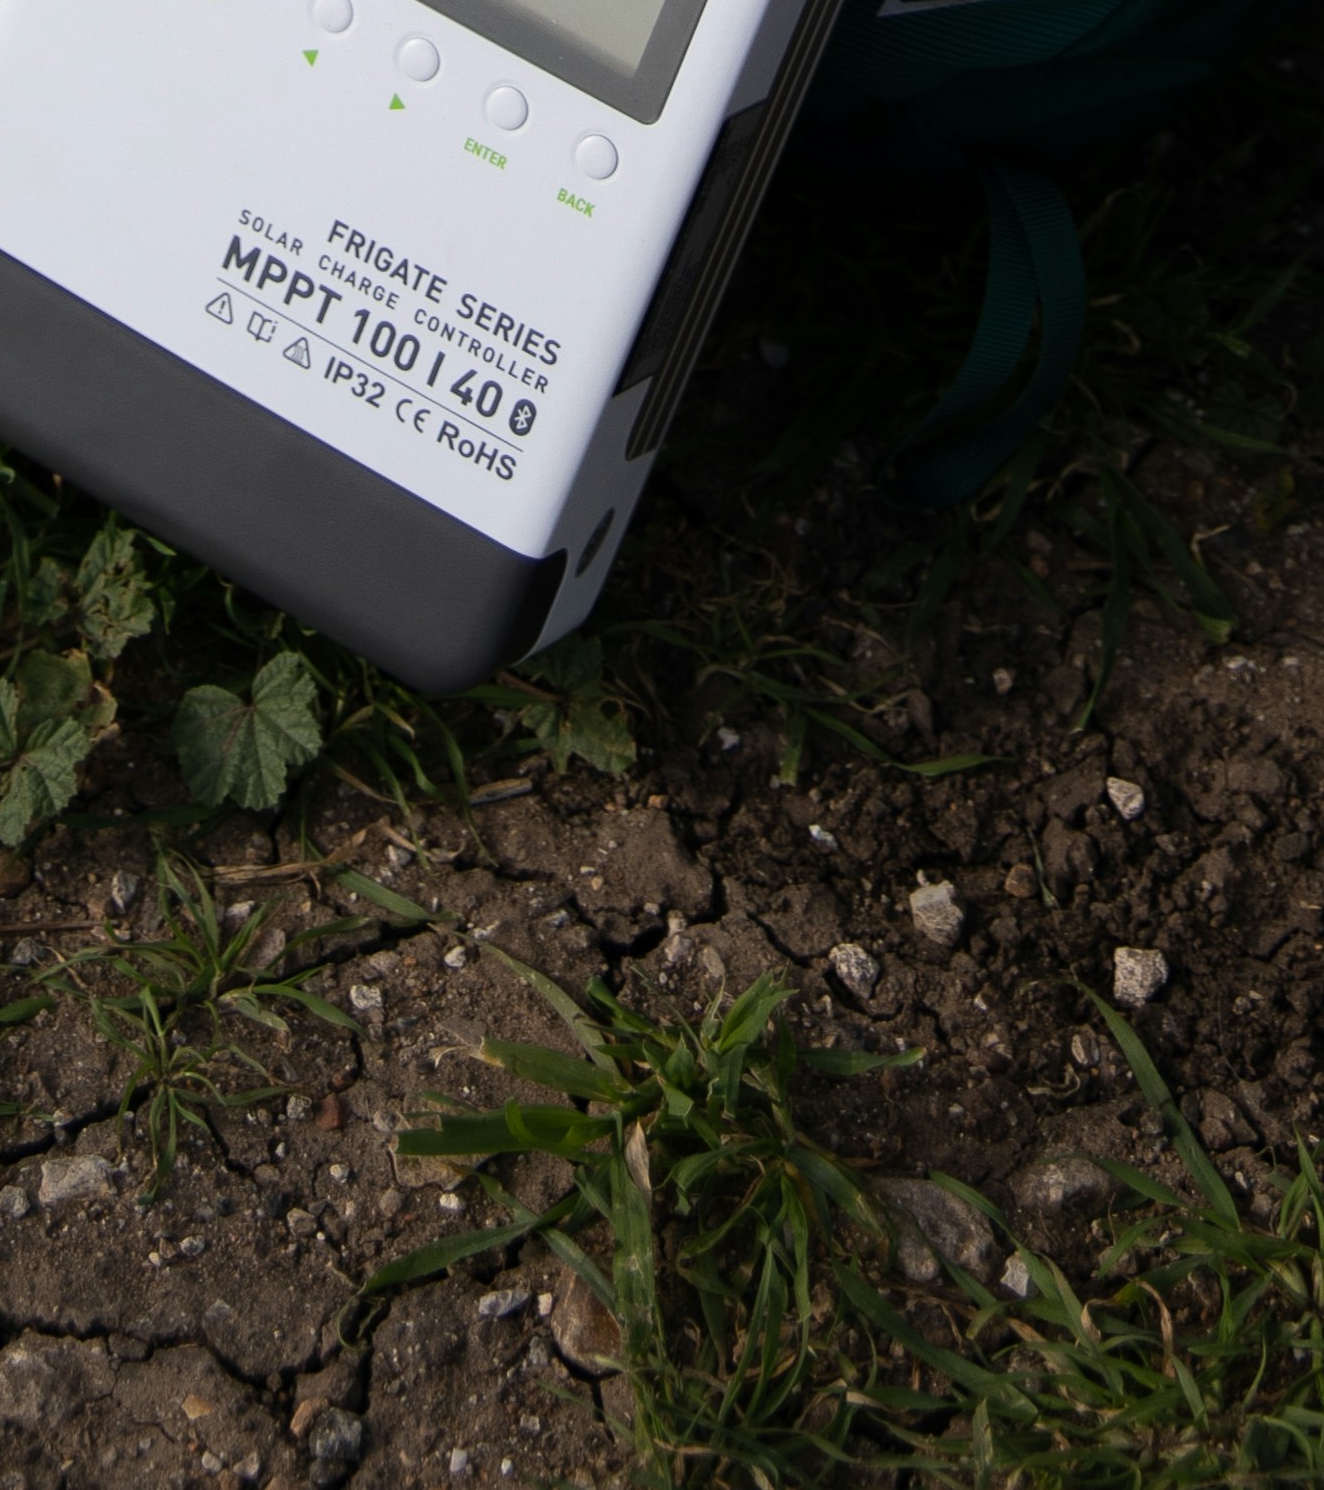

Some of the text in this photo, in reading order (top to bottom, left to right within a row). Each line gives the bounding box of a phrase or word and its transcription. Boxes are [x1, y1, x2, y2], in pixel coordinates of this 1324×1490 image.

[464, 136, 507, 170] ENTER
[556, 187, 596, 218] BACK
[222, 235, 343, 324] MPPT
[351, 308, 421, 372] 100
[450, 368, 503, 418] 40
[238, 209, 549, 394] SOLAR CHARGE CONTROLLER
[327, 219, 562, 366] FRIGATE SERIES
[323, 356, 385, 408] IP32
[436, 420, 517, 480] RoHS
